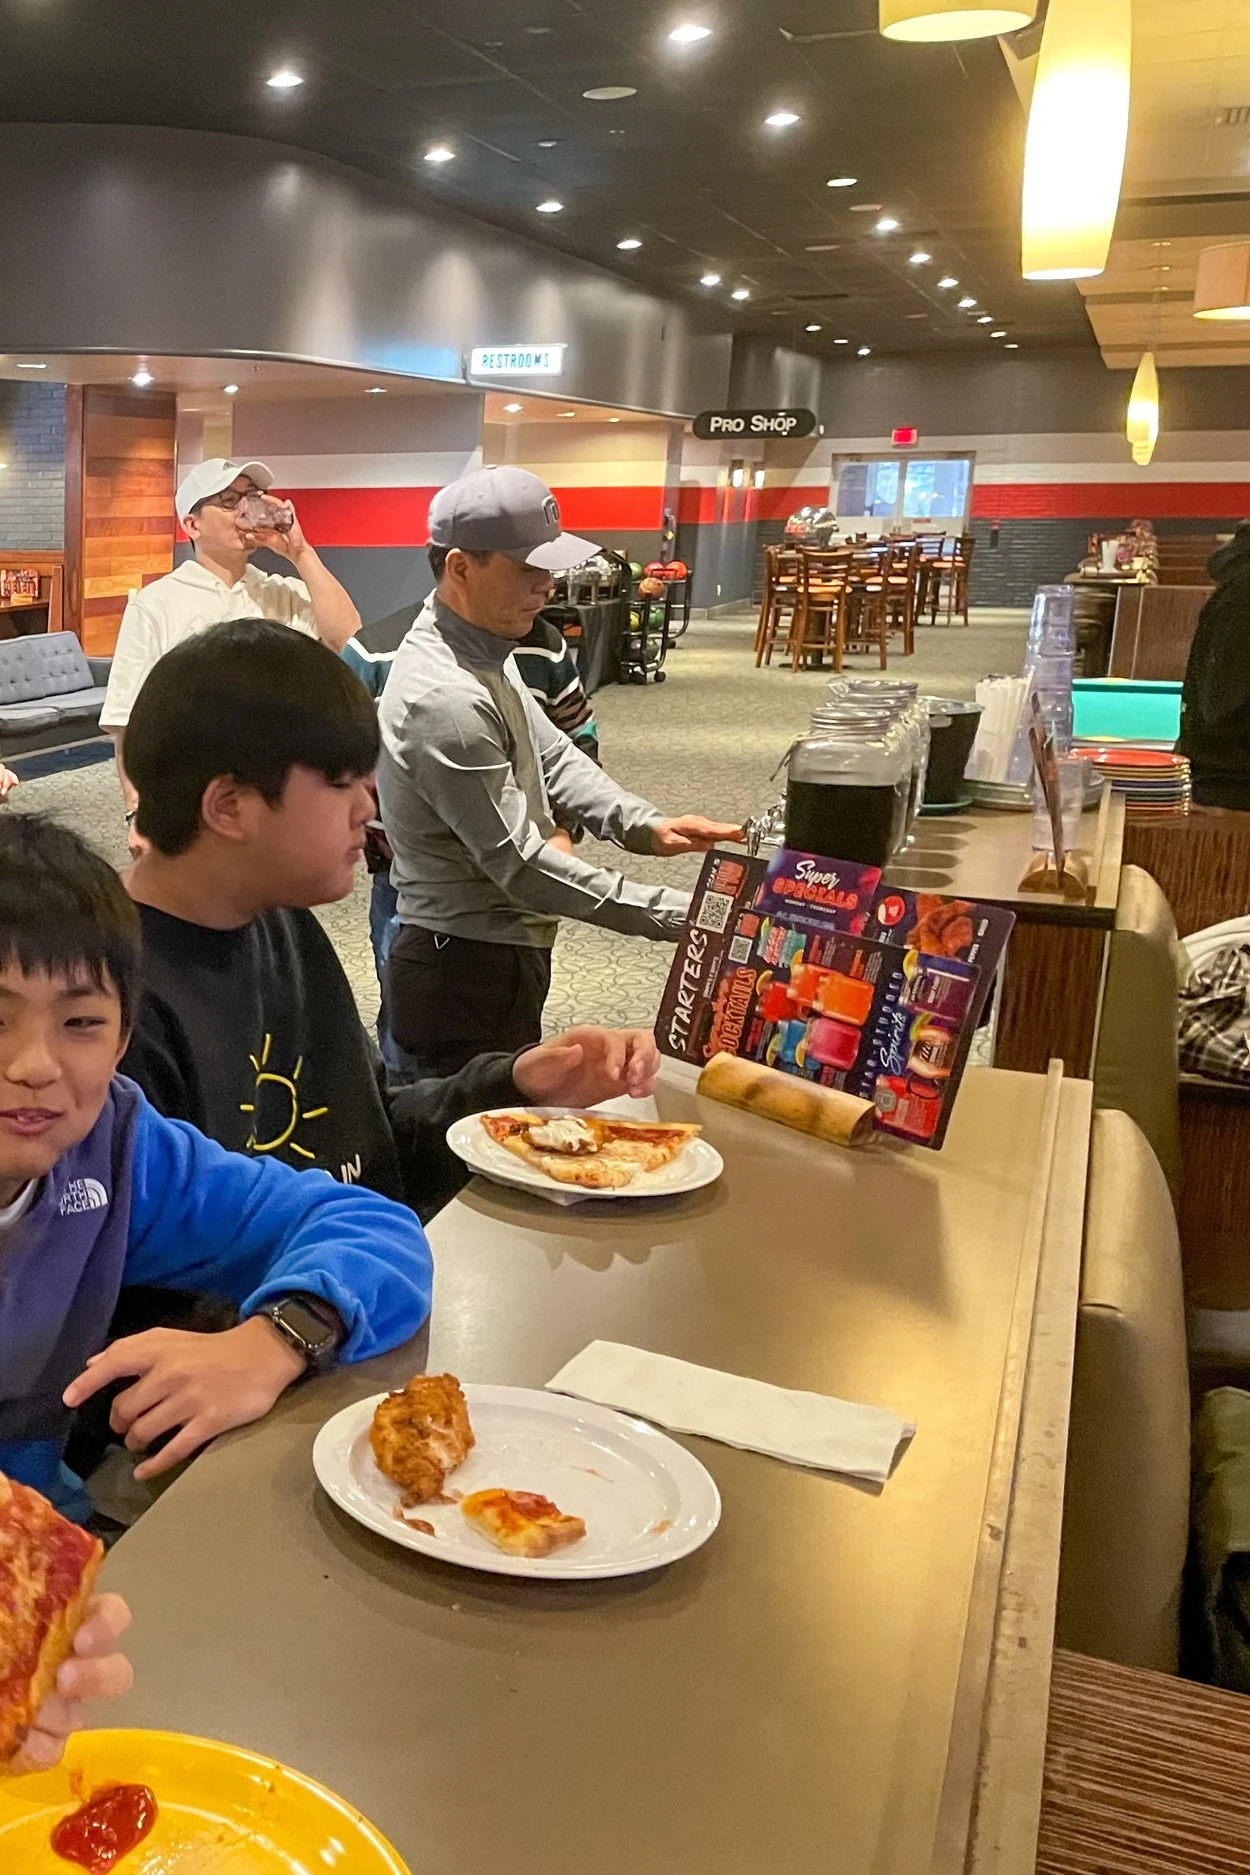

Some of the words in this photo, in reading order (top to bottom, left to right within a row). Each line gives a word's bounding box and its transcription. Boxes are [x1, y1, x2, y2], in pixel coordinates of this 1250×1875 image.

[482, 353, 550, 369] RESTROOMS
[795, 860, 840, 890] Super
[772, 877, 858, 910] SPECIALS
[668, 929, 707, 1052] STARTERS
[880, 1011, 907, 1075] Spirits
